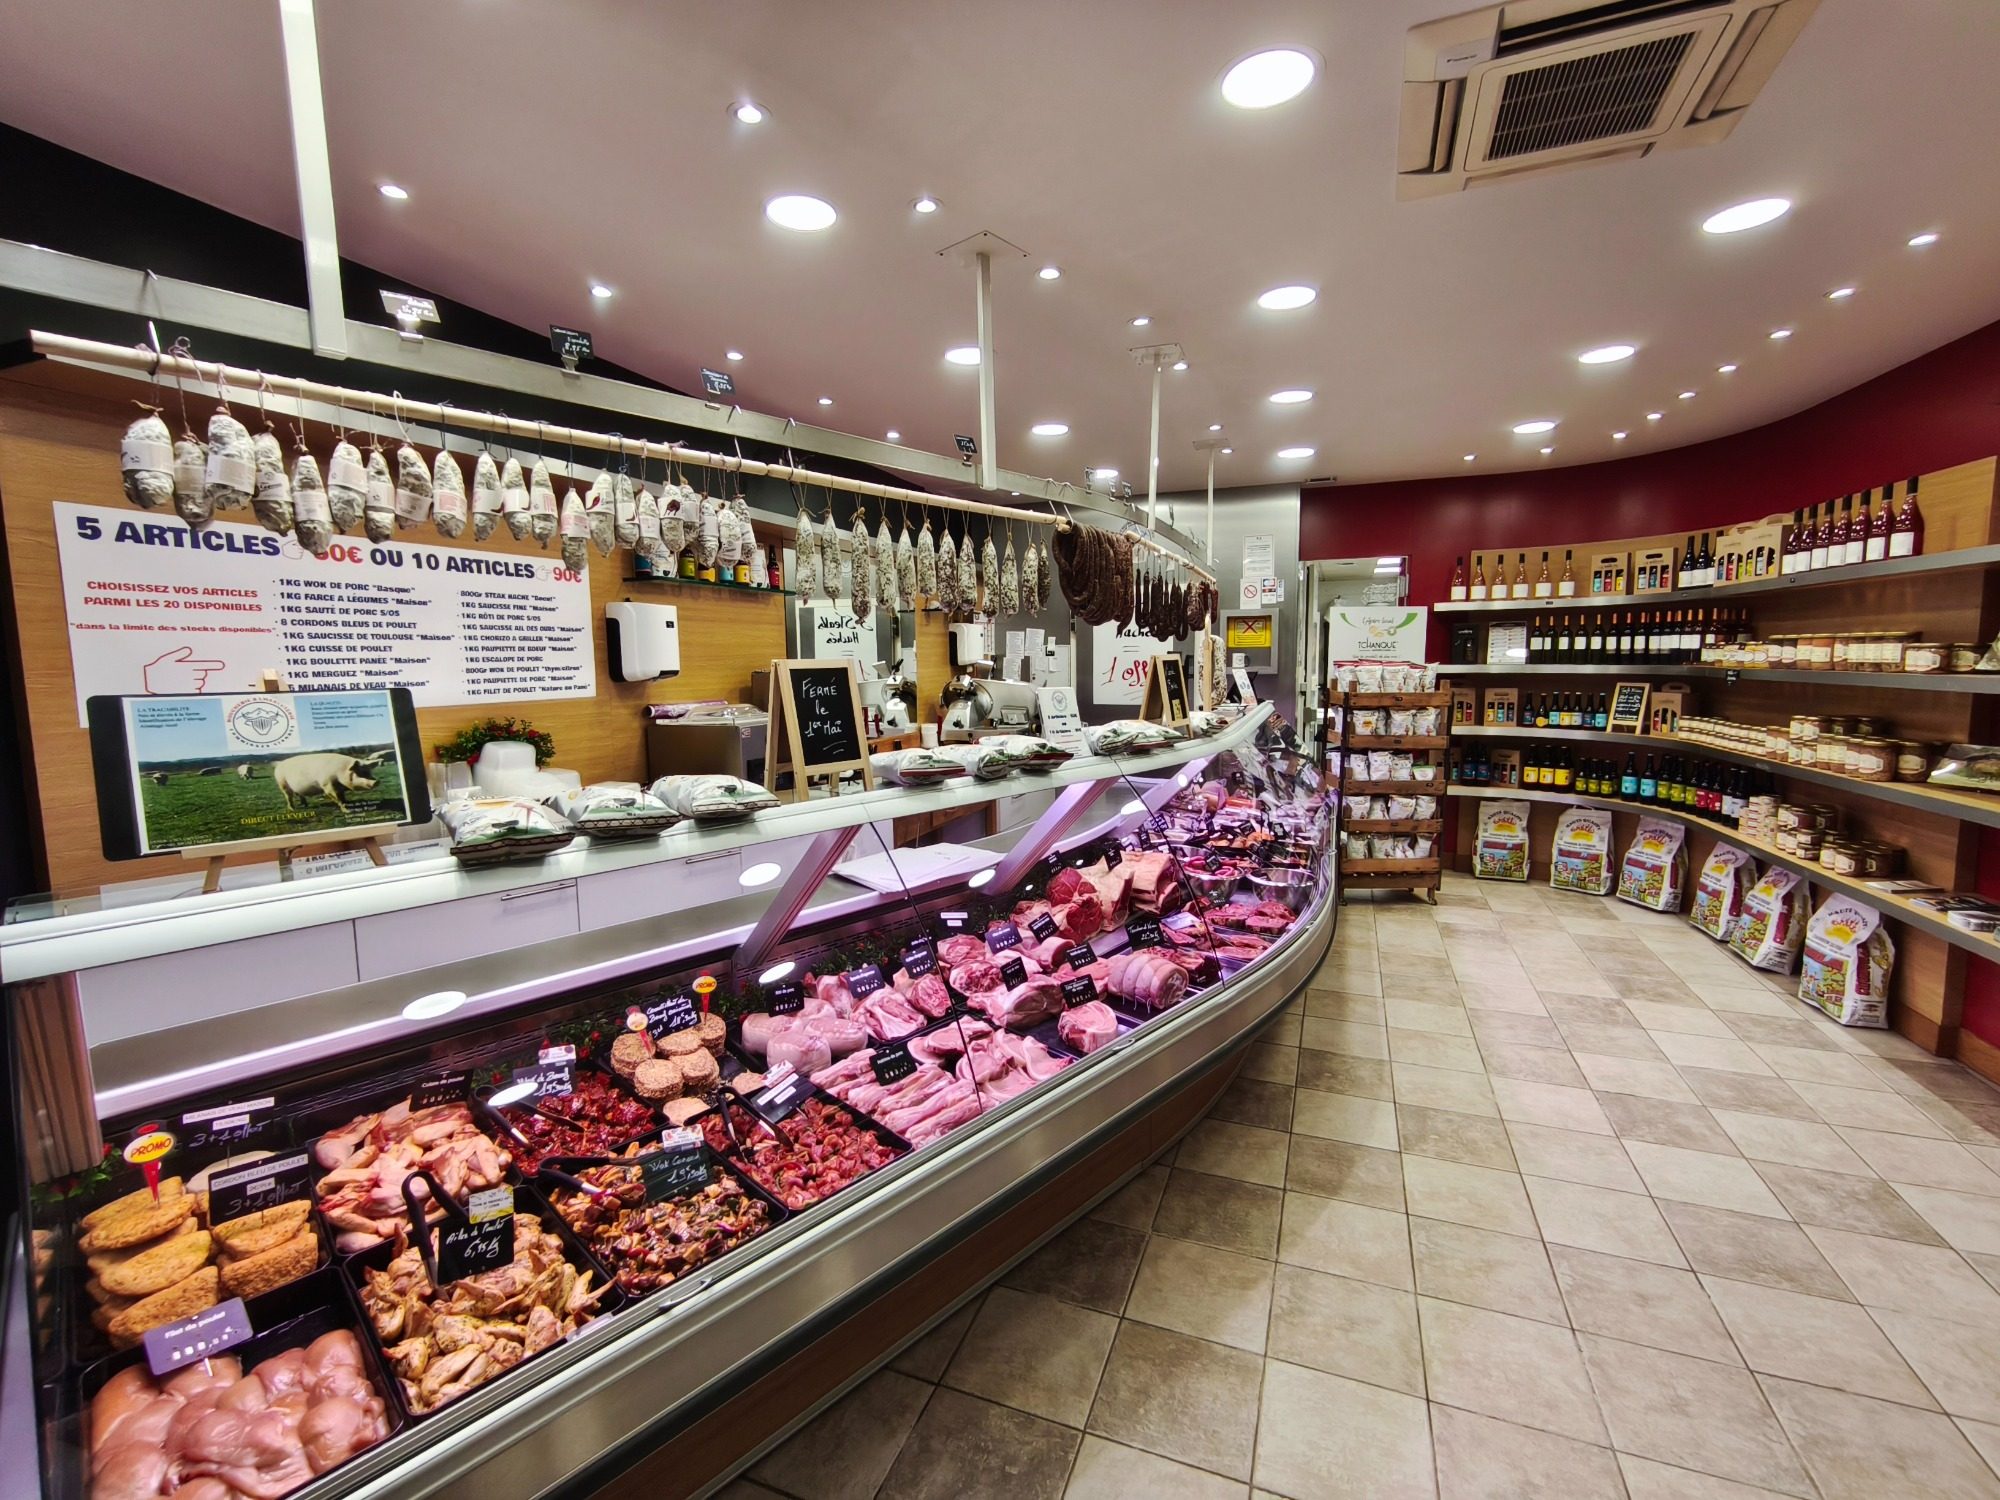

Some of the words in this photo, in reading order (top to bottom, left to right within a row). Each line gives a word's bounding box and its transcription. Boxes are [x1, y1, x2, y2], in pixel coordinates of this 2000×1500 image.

[76, 516, 102, 540] 5
[115, 521, 280, 556] ARTICLES
[370, 547, 403, 567] OU
[412, 552, 439, 570] 10
[446, 556, 535, 579] ARTICLES
[553, 566, 582, 583] 90€
[87, 580, 169, 594] CHOISISSEZ
[173, 586, 198, 596] VOS
[202, 587, 258, 598] ARTICLES
[304, 579, 327, 589] WOK
[330, 581, 342, 590] DE
[345, 582, 370, 591] PORC
[84, 596, 131, 607] PARMI
[136, 598, 160, 608] LES
[163, 599, 180, 609] 20
[184, 601, 262, 612] DISPONIBLES
[304, 593, 335, 602] FARCE
[347, 592, 389, 604] LÉGUMES
[305, 604, 336, 614] SAUTÉ
[338, 607, 350, 615] DE
[353, 608, 377, 616] PORC
[380, 609, 400, 617] S/OS
[478, 602, 511, 610] SAUCISSE
[123, 623, 154, 631] limite
[290, 619, 339, 627] CORDONS
[341, 620, 369, 628] BLEUS
[386, 621, 417, 629] POULET
[307, 632, 355, 640] SAUCISSE
[310, 657, 357, 665] BOULETTE
[311, 670, 357, 678] MERGUEZ
[298, 682, 347, 691] MILANAIS
[349, 682, 361, 690] DE
[364, 681, 386, 689] VEAU
[802, 677, 838, 699] FERMÉ
[815, 699, 830, 715] le
[130, 1138, 172, 1158] PROMO
